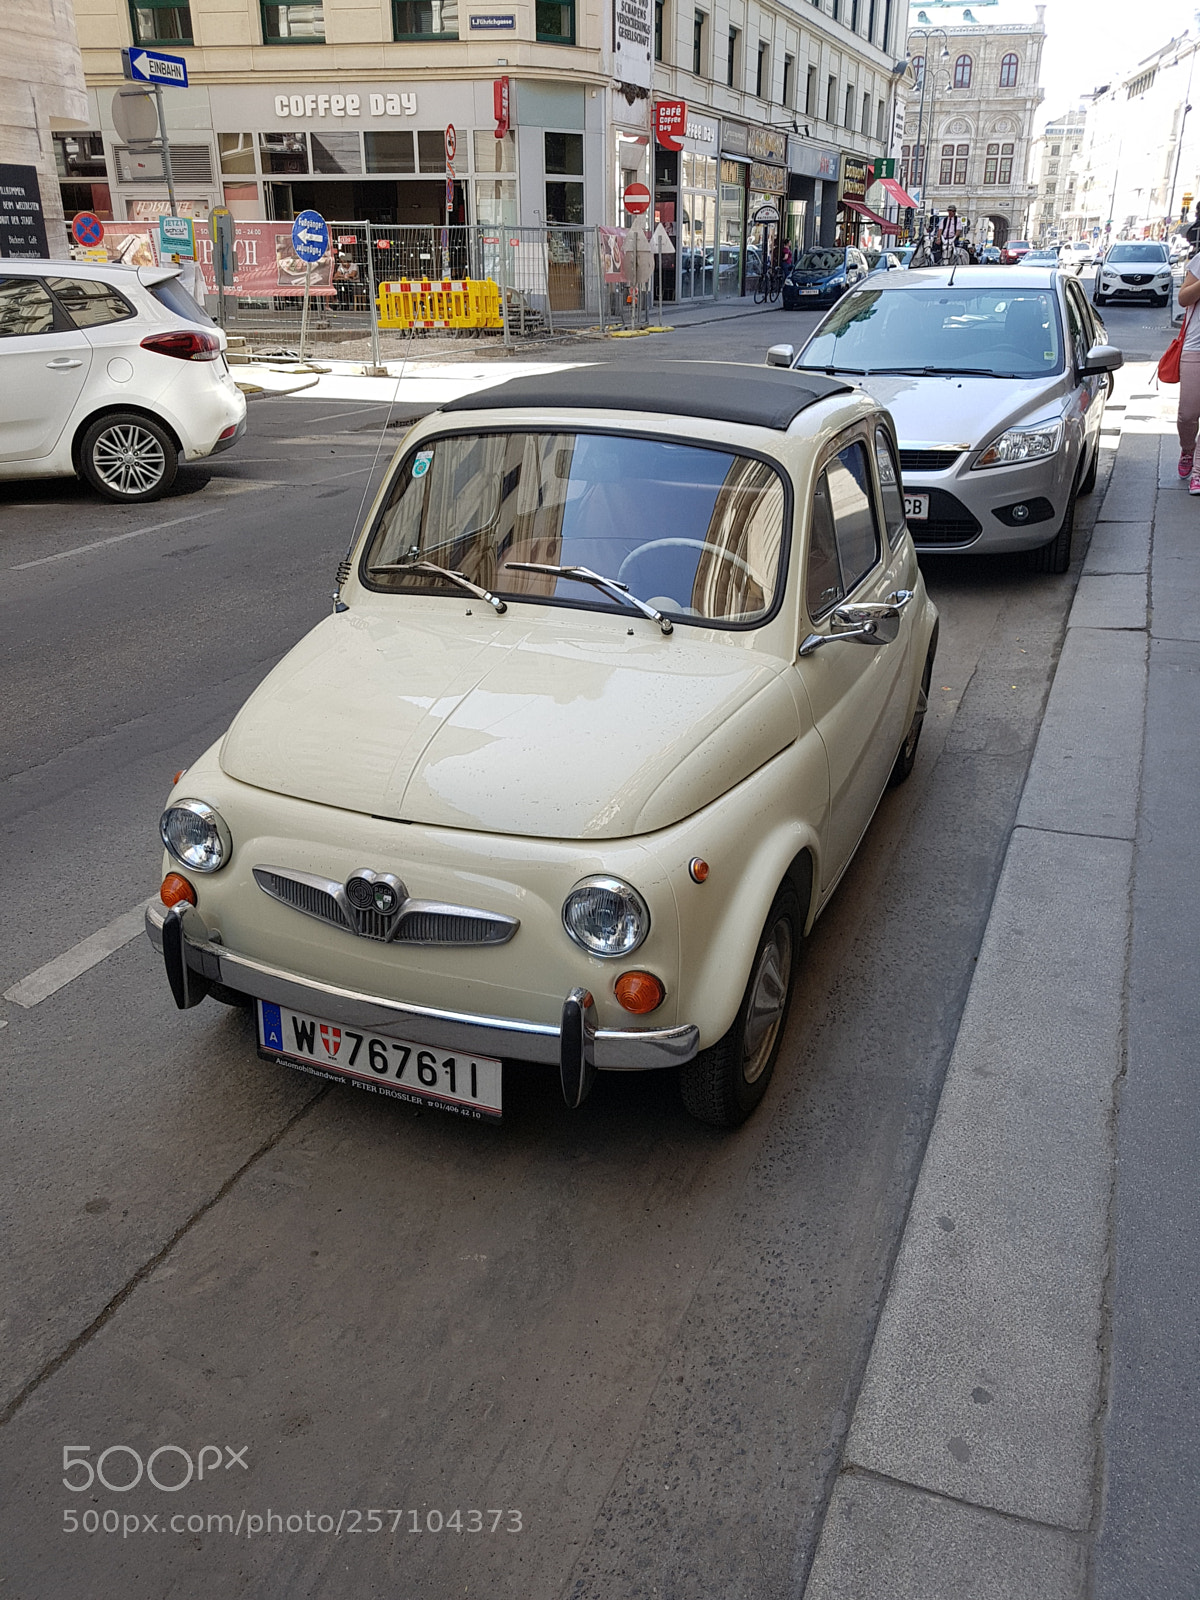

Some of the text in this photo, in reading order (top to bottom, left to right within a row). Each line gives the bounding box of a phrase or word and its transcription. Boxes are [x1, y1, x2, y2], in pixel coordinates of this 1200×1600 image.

[619, 26, 649, 47] GESELLSCHAFT
[149, 60, 182, 78] EINBAHN
[298, 217, 324, 231] Fußgänger
[375, 887, 392, 895] PUCH
[269, 1031, 279, 1043] A
[291, 1015, 316, 1055] W
[275, 1057, 347, 1084] Automobilhandwerk
[351, 1079, 377, 1094] PETER
[460, 1109, 470, 1117] 42
[471, 1111, 481, 1119] 10
